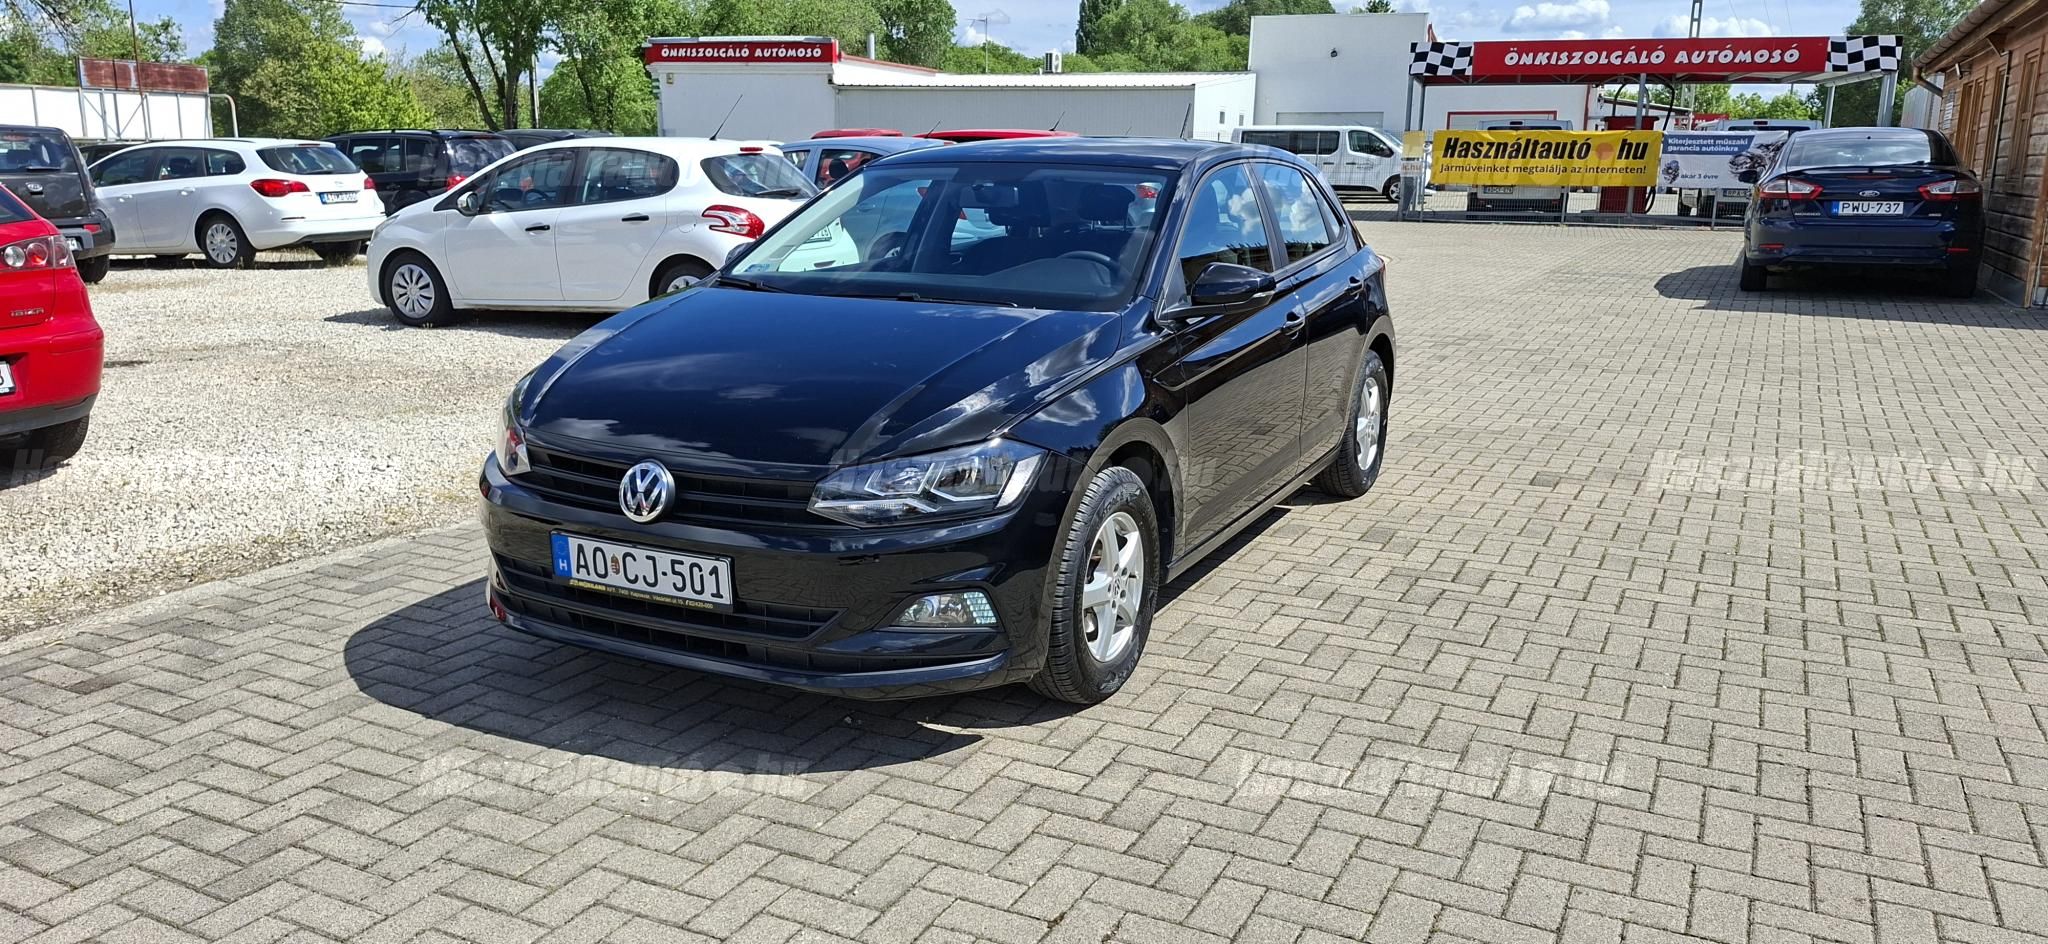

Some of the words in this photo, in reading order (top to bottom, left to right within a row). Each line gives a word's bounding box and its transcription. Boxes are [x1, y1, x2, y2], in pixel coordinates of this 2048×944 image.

[661, 45, 749, 58] ÖNKISZOLGÁLÓ
[754, 45, 822, 58] AUTÓMOSÓ
[1504, 46, 1666, 65] ÖNKISZOLGÁLÓ
[1674, 44, 1800, 64] AUTÓMOSÓ
[1668, 137, 1714, 146] Kiterjesztett
[1702, 144, 1739, 152] autóinkra
[1440, 163, 1510, 174] Járműveinket
[1512, 164, 1568, 175] megtalálja
[1585, 165, 1647, 174] interneten!
[1841, 202, 1901, 214] PWU-737
